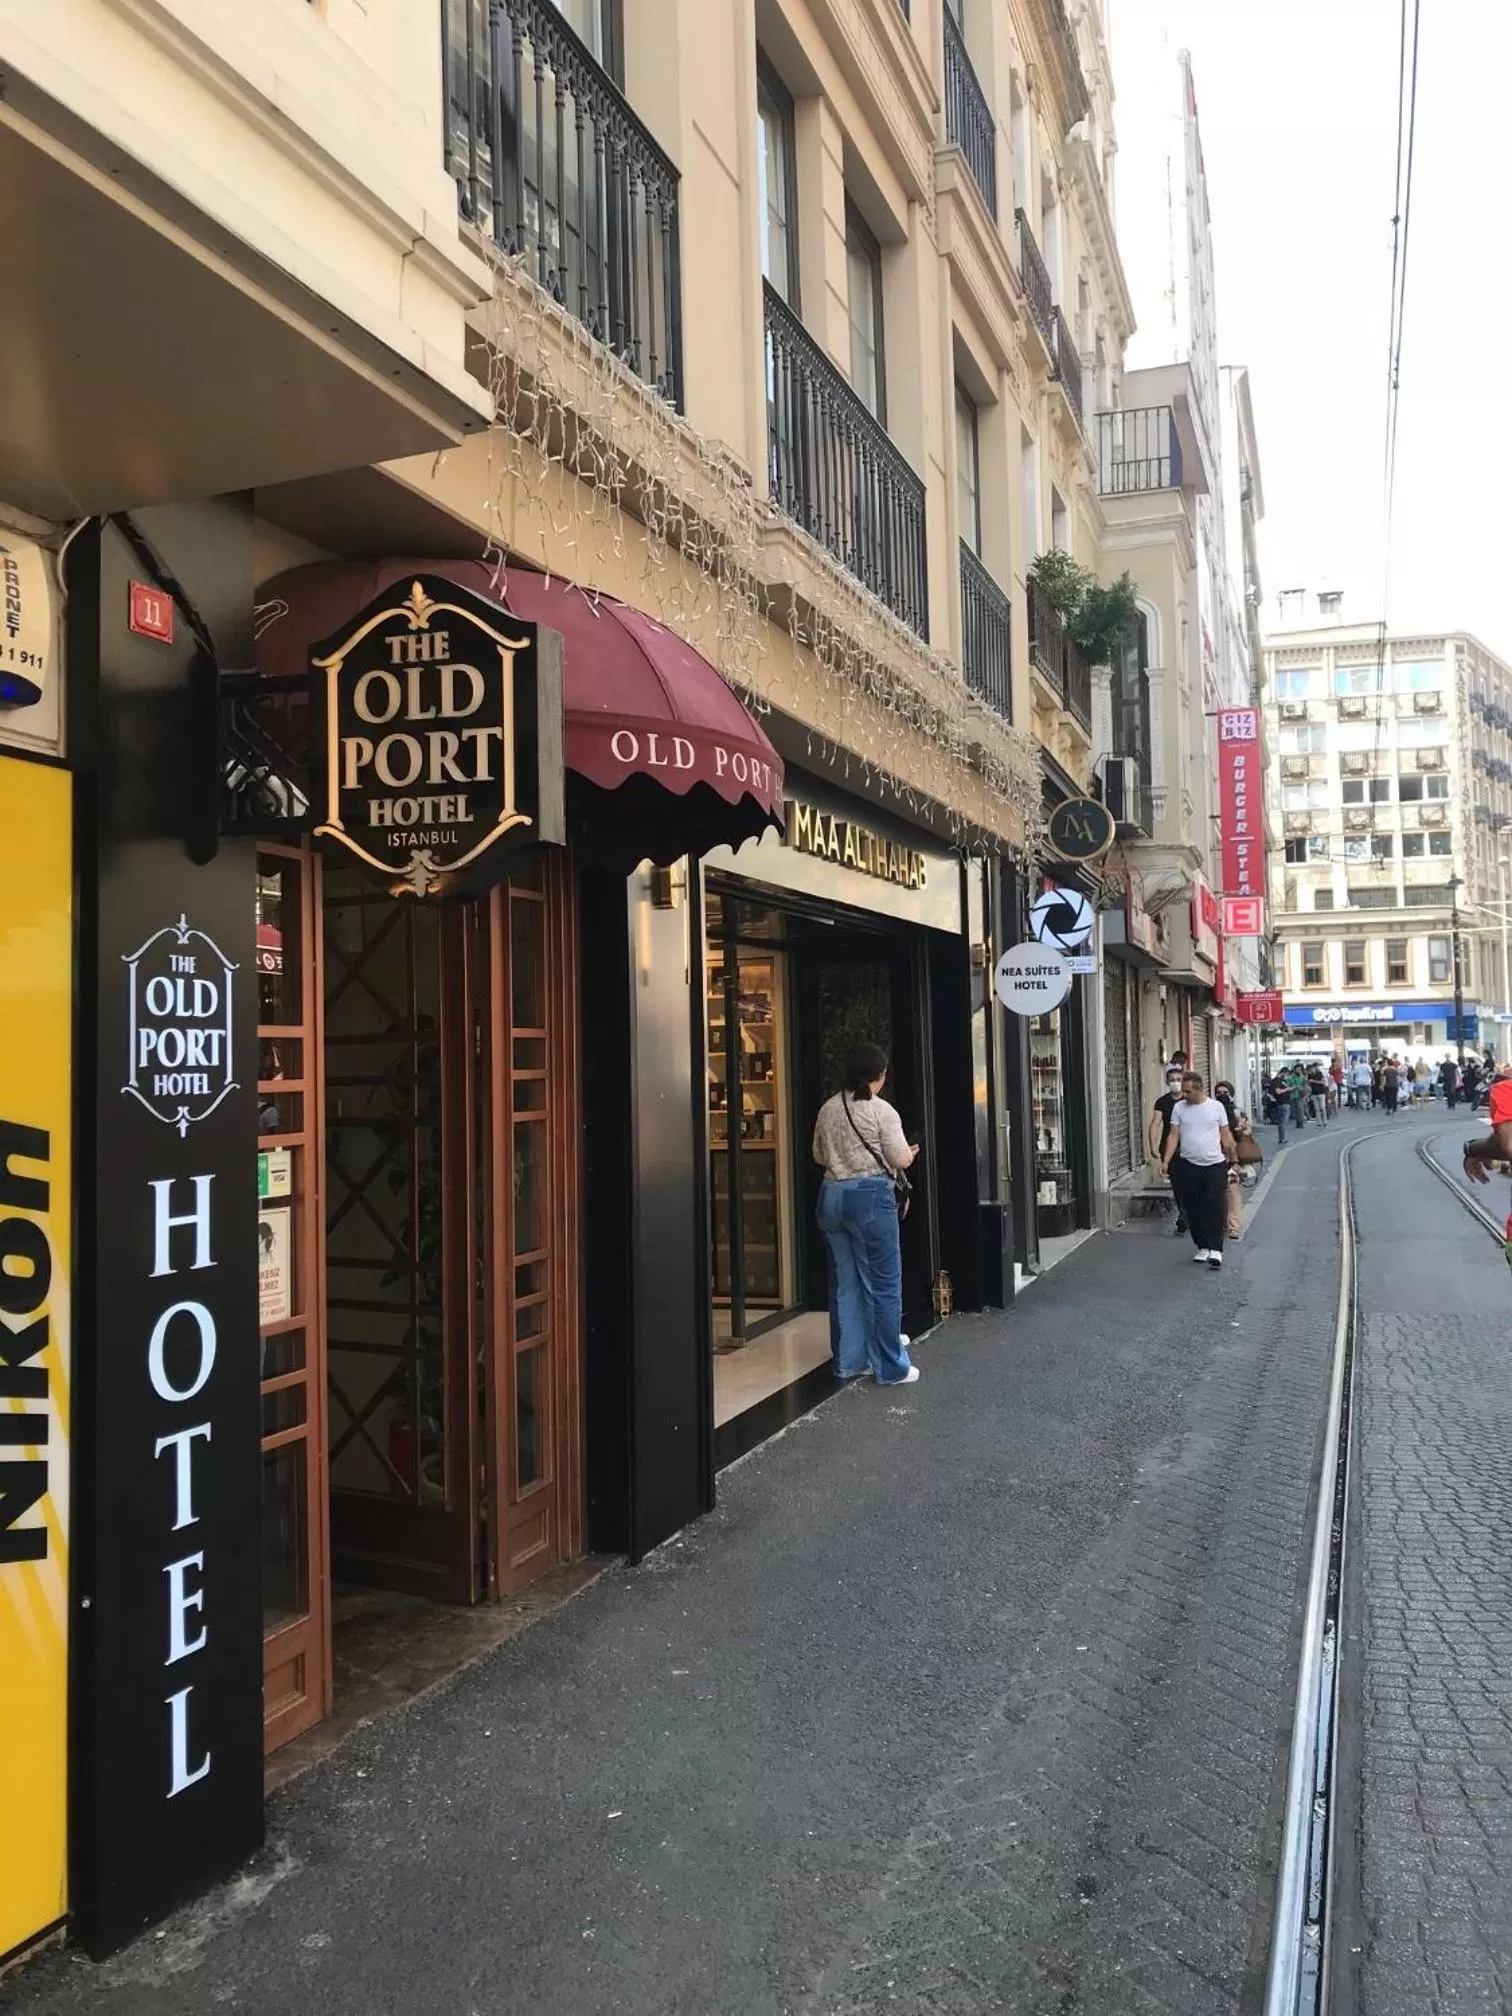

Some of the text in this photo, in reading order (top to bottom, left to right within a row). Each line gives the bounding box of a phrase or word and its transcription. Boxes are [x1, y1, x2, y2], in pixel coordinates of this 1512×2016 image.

[4, 558, 20, 638] PRONET
[143, 598, 162, 626] 11
[385, 631, 449, 664] THE
[353, 663, 485, 724] OLD
[341, 726, 503, 790] PORT
[611, 730, 695, 770] OLD
[714, 746, 771, 793] PORT
[368, 794, 474, 827] HOTEL
[387, 830, 458, 847] ISTANBUL
[169, 954, 197, 974] THE
[1002, 967, 1022, 976] NEA
[145, 976, 218, 1017] OLD
[1014, 981, 1048, 990] HOTEL
[138, 1028, 226, 1068] PORT
[153, 1073, 212, 1096] HOTEL
[147, 1173, 218, 1800] HOTEL
